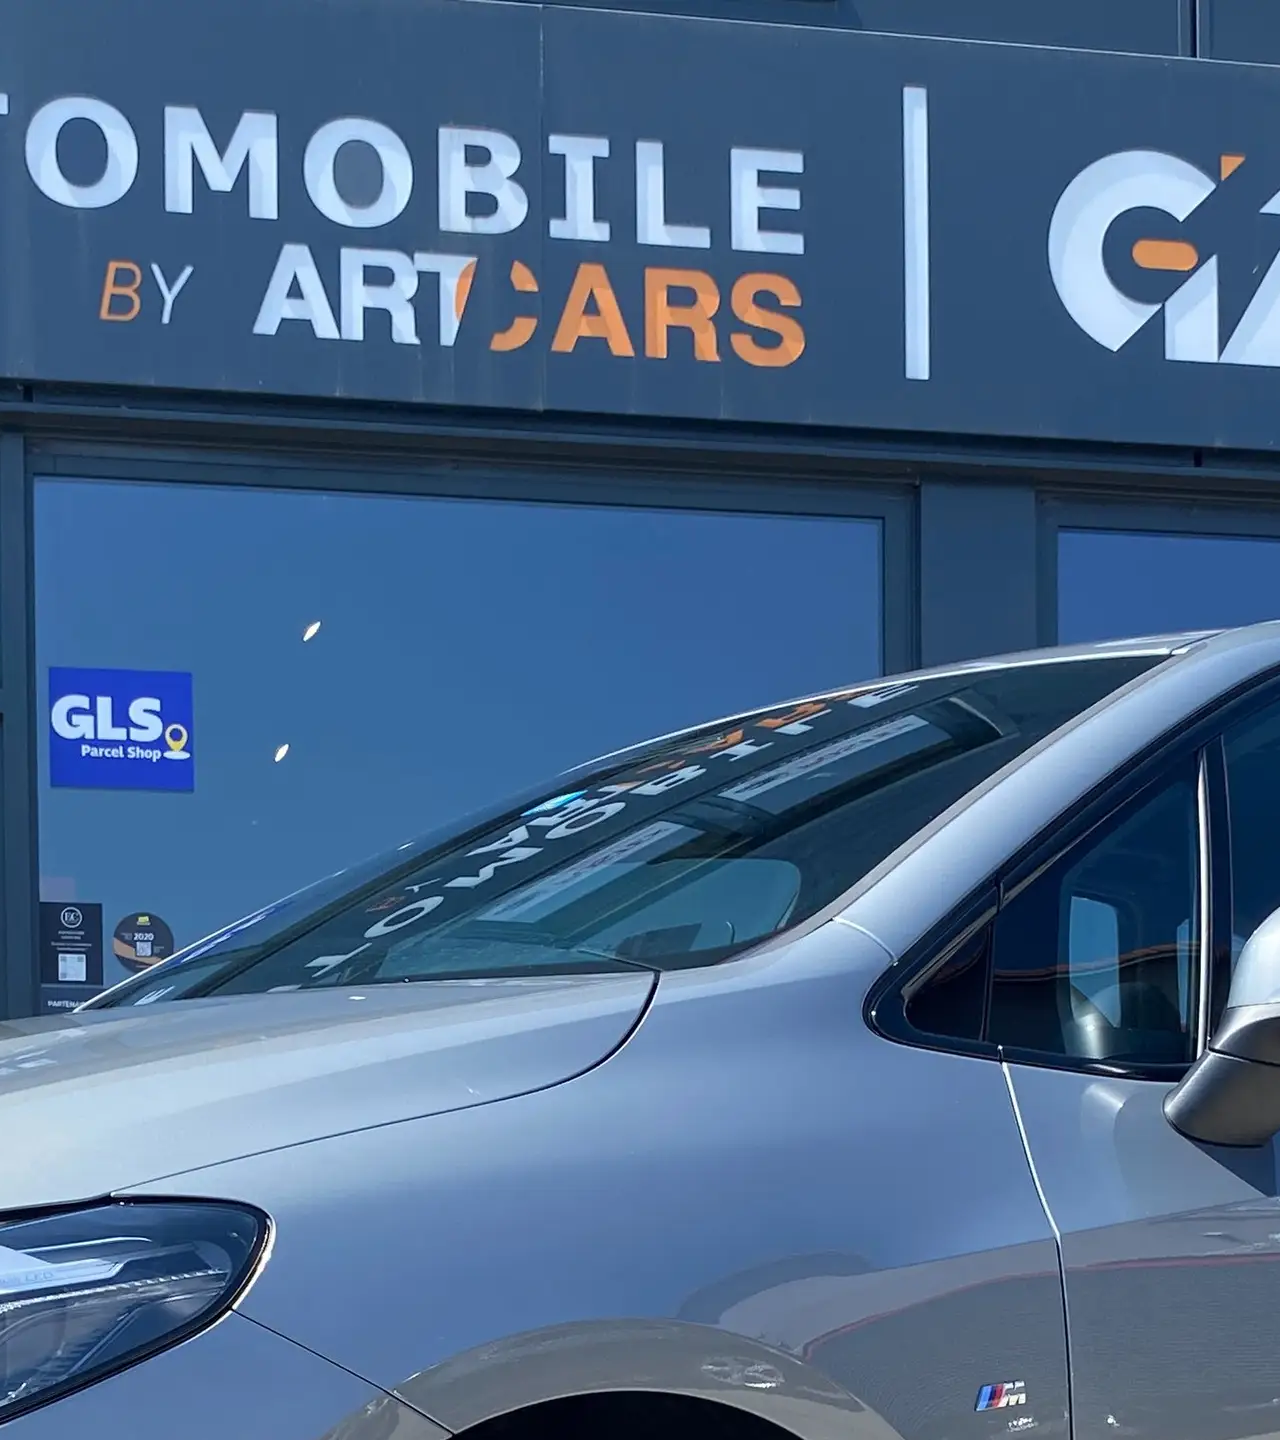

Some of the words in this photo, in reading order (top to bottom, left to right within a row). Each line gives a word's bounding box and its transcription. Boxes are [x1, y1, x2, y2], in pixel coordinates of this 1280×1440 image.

[99, 260, 194, 325] BY
[51, 694, 164, 743] GLS
[81, 744, 125, 760] Parcel
[127, 745, 163, 763] Shop
[133, 931, 155, 941] 2020
